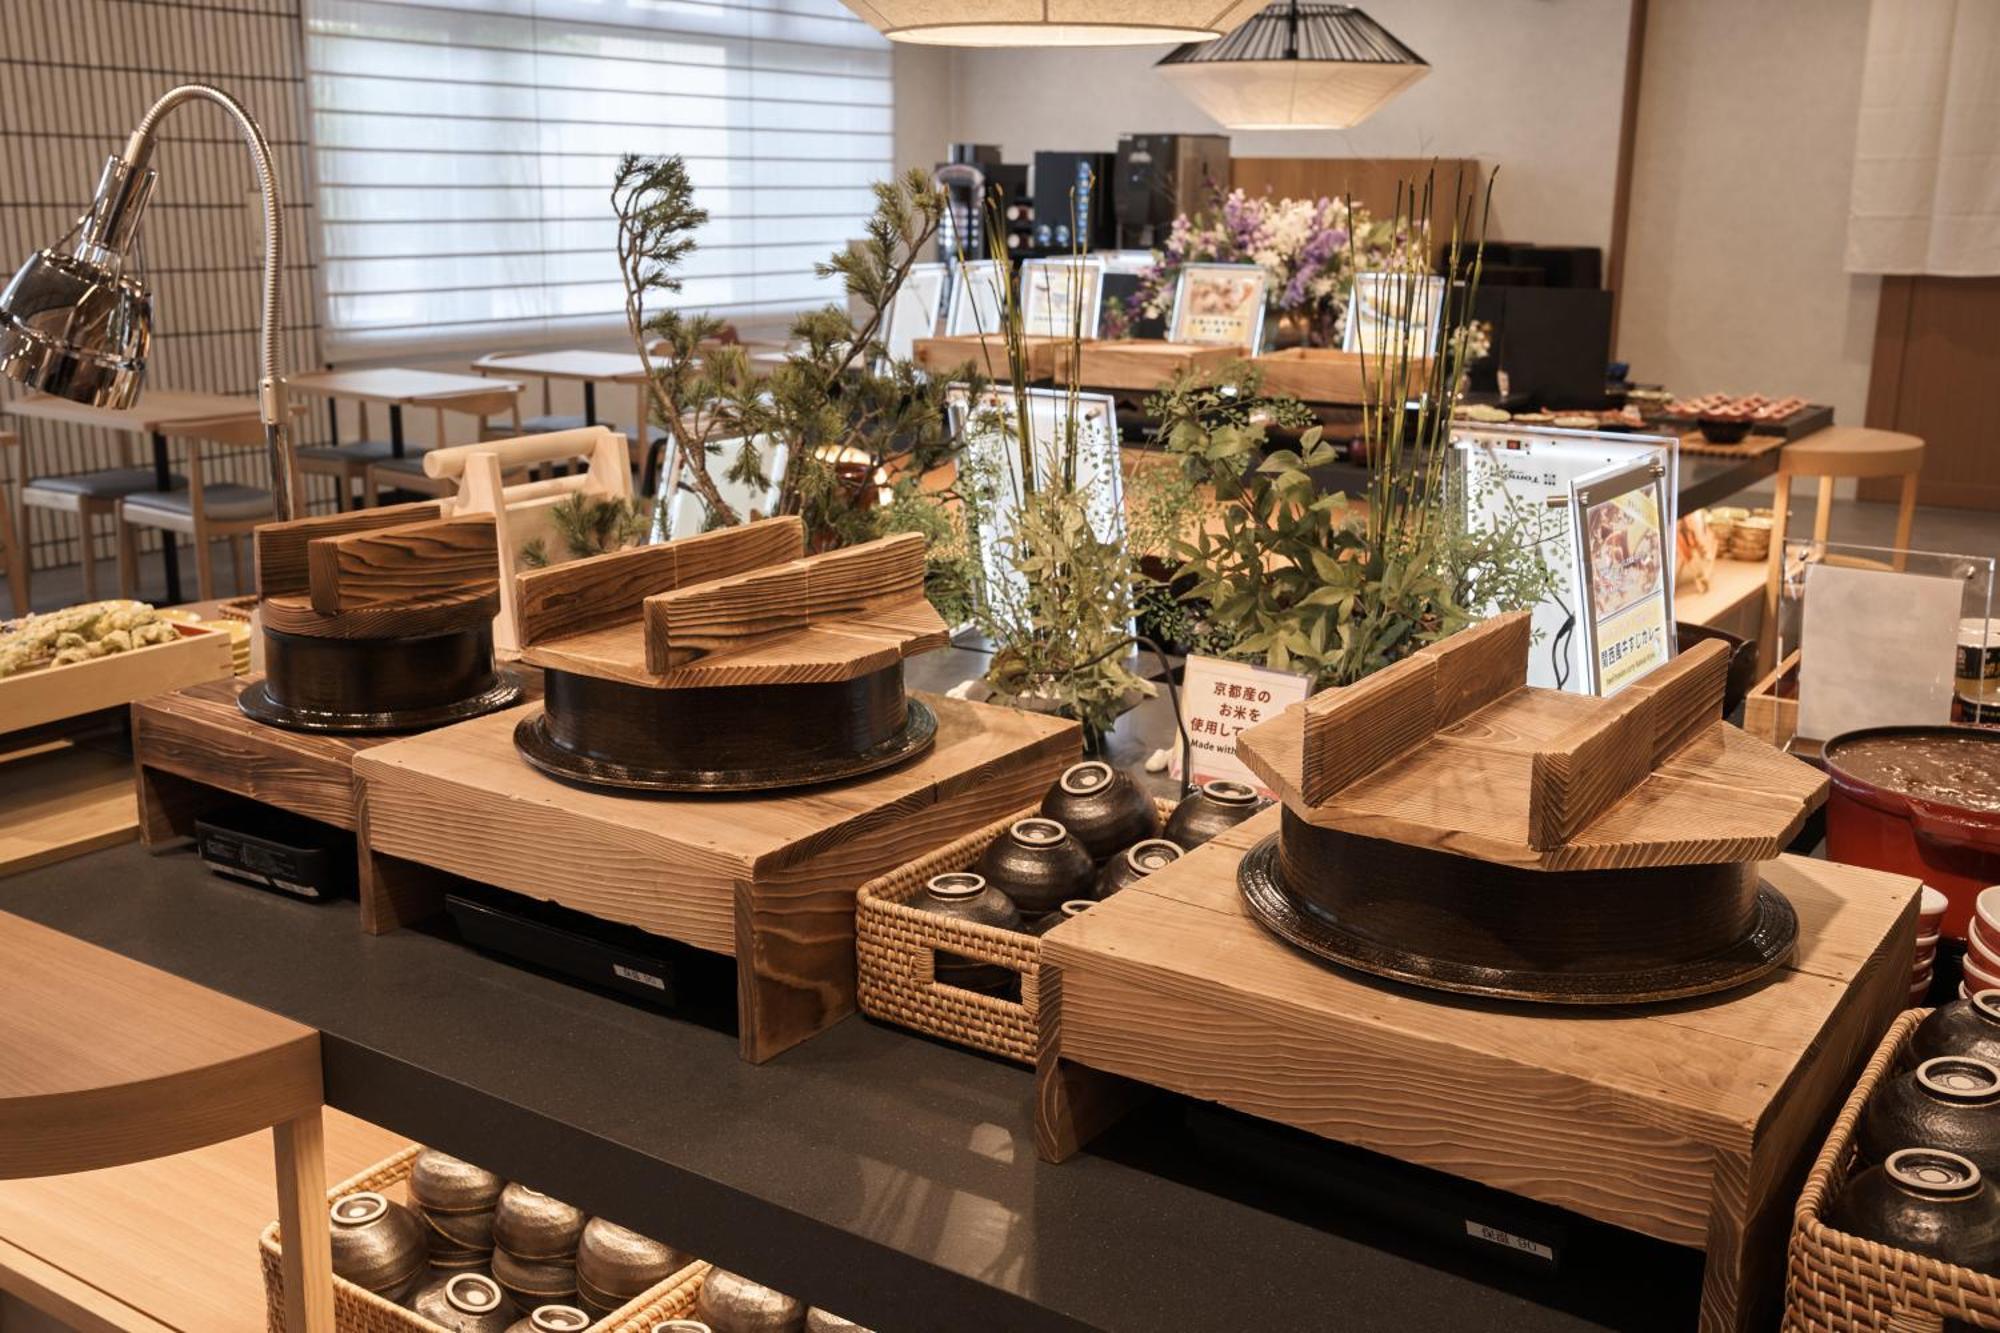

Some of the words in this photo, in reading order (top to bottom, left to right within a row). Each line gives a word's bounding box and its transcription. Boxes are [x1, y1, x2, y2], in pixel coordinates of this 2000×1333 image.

[1213, 681, 1271, 704] 京都産の
[1218, 703, 1262, 723] お米を
[1190, 738, 1215, 751] Made
[1216, 745, 1237, 755] with
